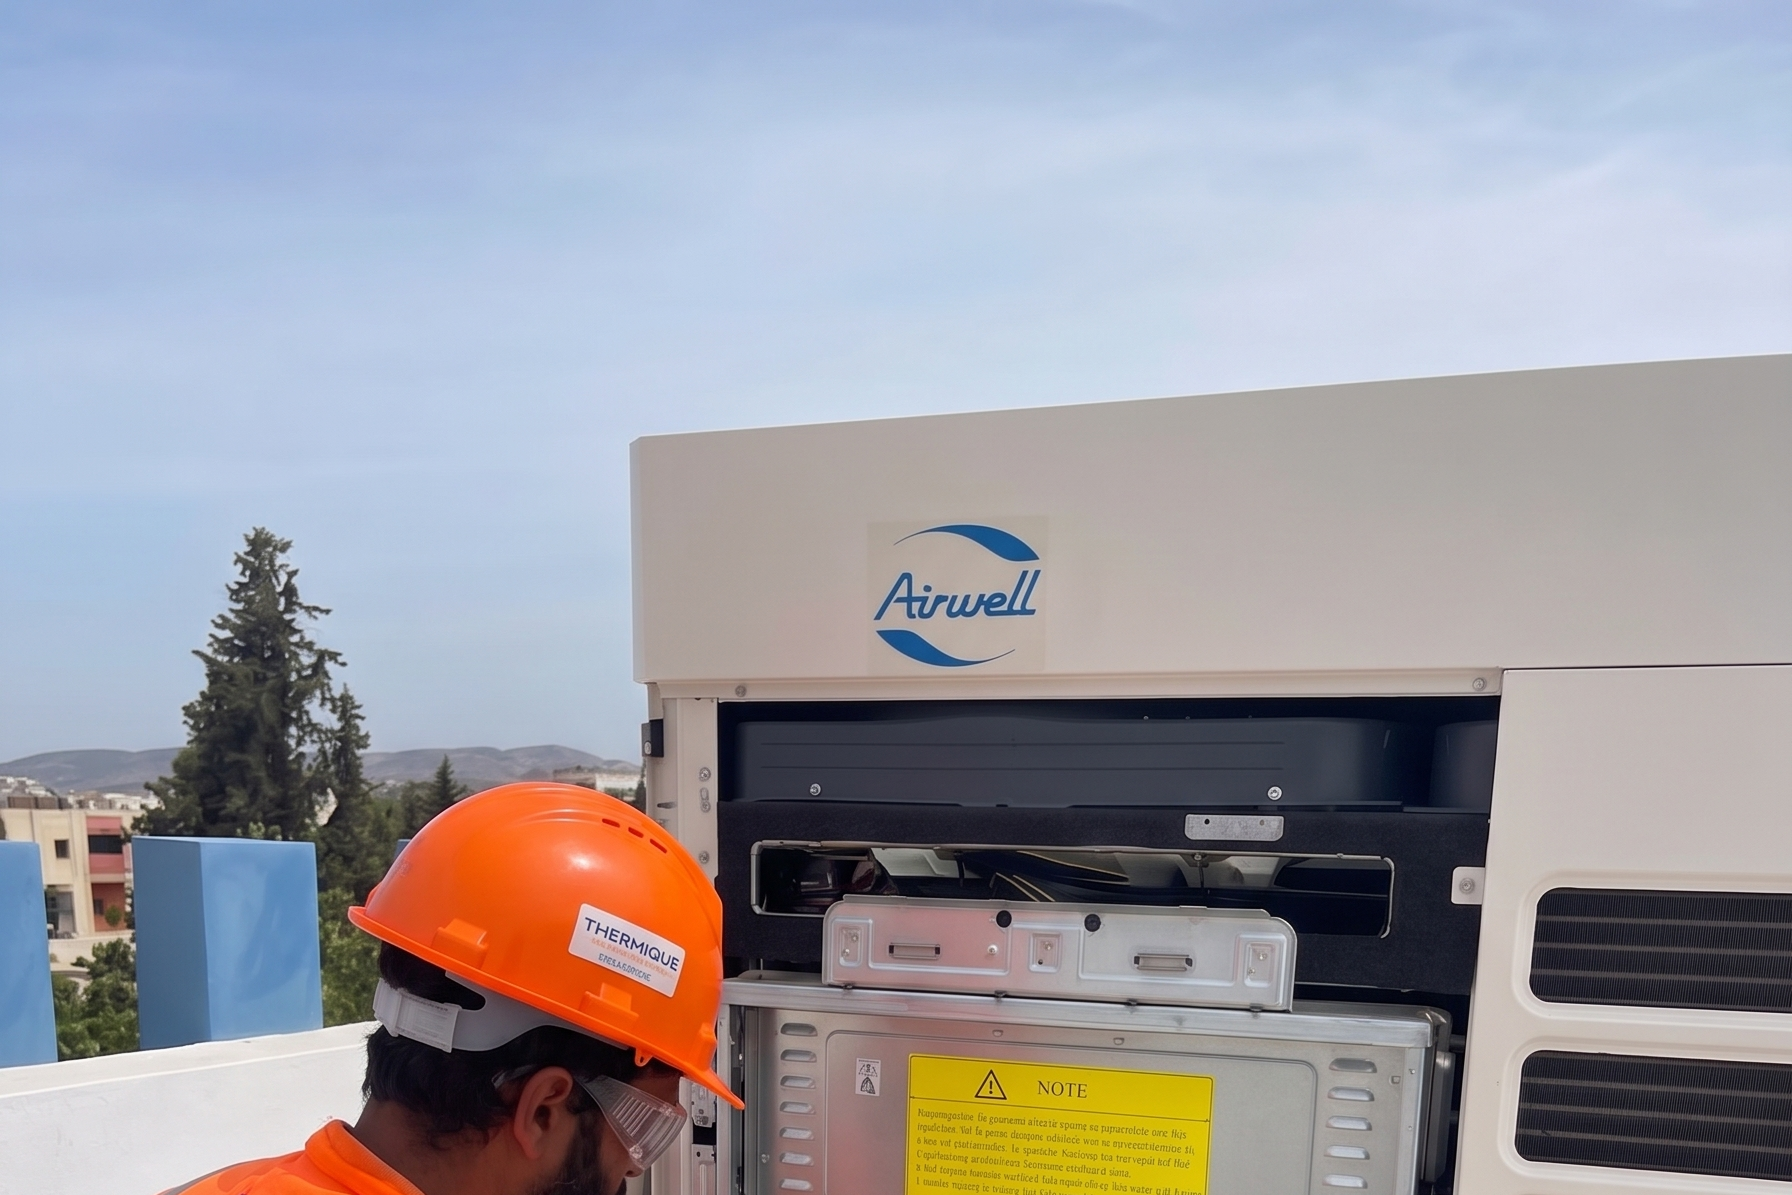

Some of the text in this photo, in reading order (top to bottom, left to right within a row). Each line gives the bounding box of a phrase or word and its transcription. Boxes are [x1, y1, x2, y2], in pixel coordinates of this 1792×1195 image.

[873, 569, 1042, 621] Airwell
[584, 916, 680, 972] THERMIQUE
[1037, 1080, 1088, 1099] NOTE
